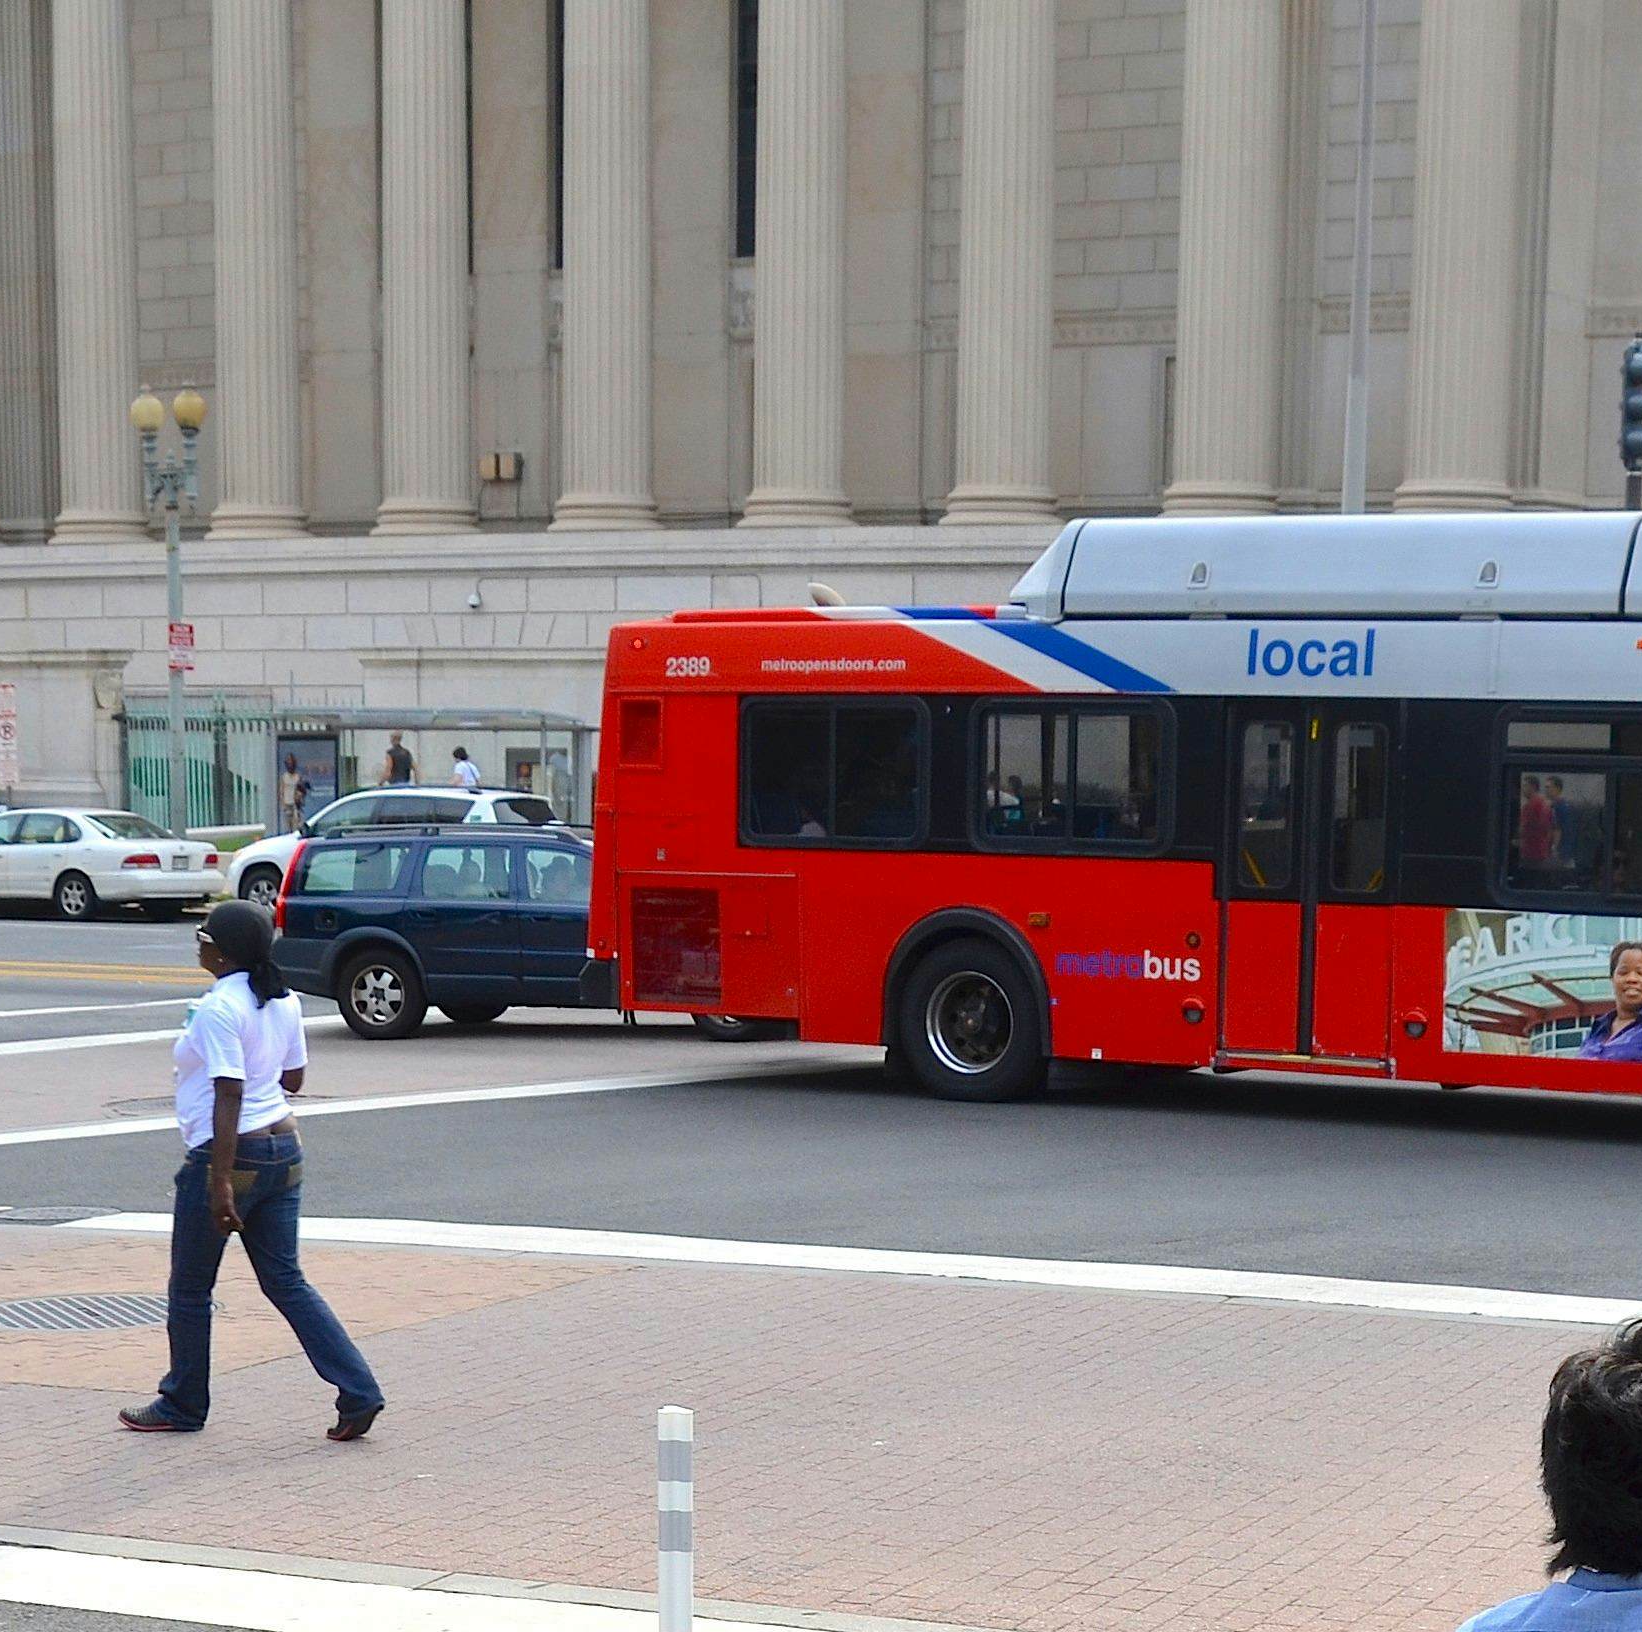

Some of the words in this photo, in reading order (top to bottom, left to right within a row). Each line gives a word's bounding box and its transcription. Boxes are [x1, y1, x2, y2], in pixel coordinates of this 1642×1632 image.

[761, 657, 907, 674] metroopensdoors.com
[1248, 628, 1376, 677] local
[665, 656, 711, 677] 2389
[1055, 949, 1202, 982] metrobus
